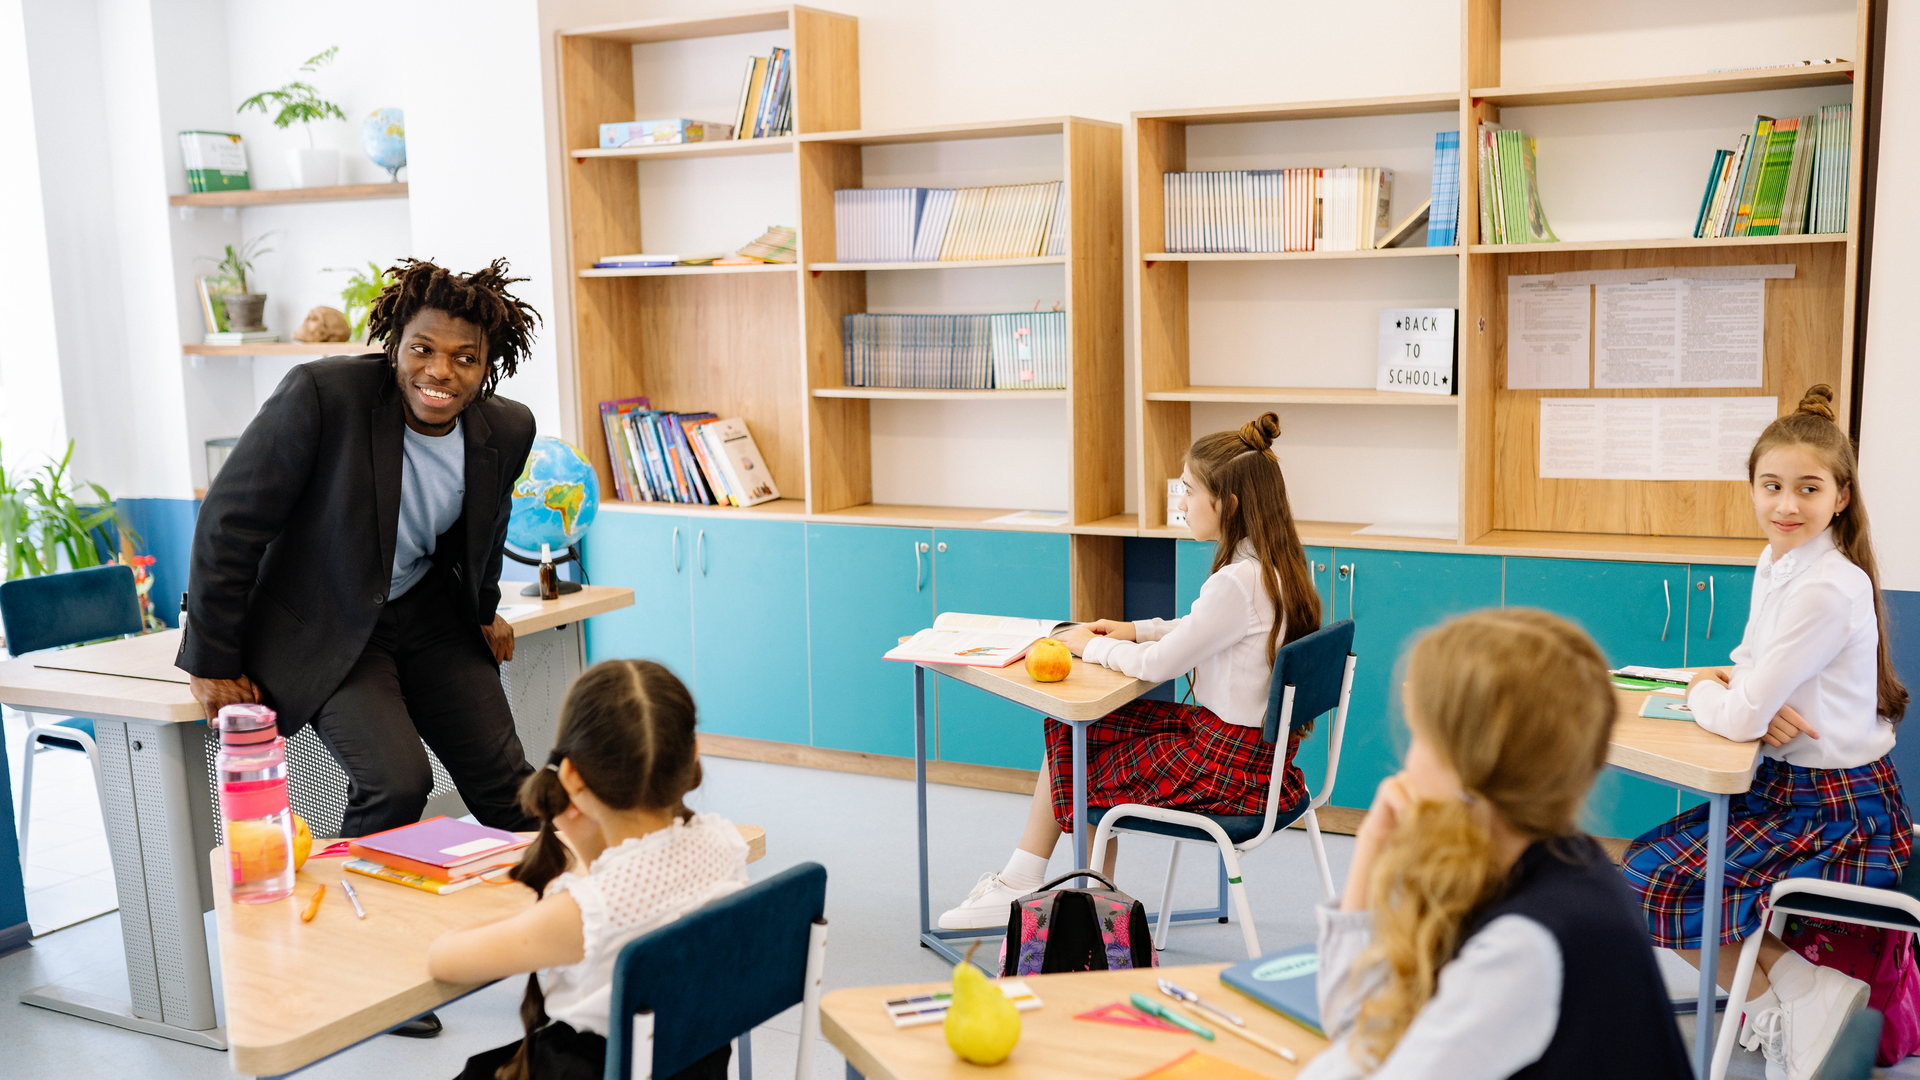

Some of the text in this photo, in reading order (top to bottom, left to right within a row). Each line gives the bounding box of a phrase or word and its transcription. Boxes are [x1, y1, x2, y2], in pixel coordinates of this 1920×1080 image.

[1404, 316, 1437, 331] BACK
[1405, 343, 1420, 358] TO
[1389, 369, 1438, 386] SCHOOL
